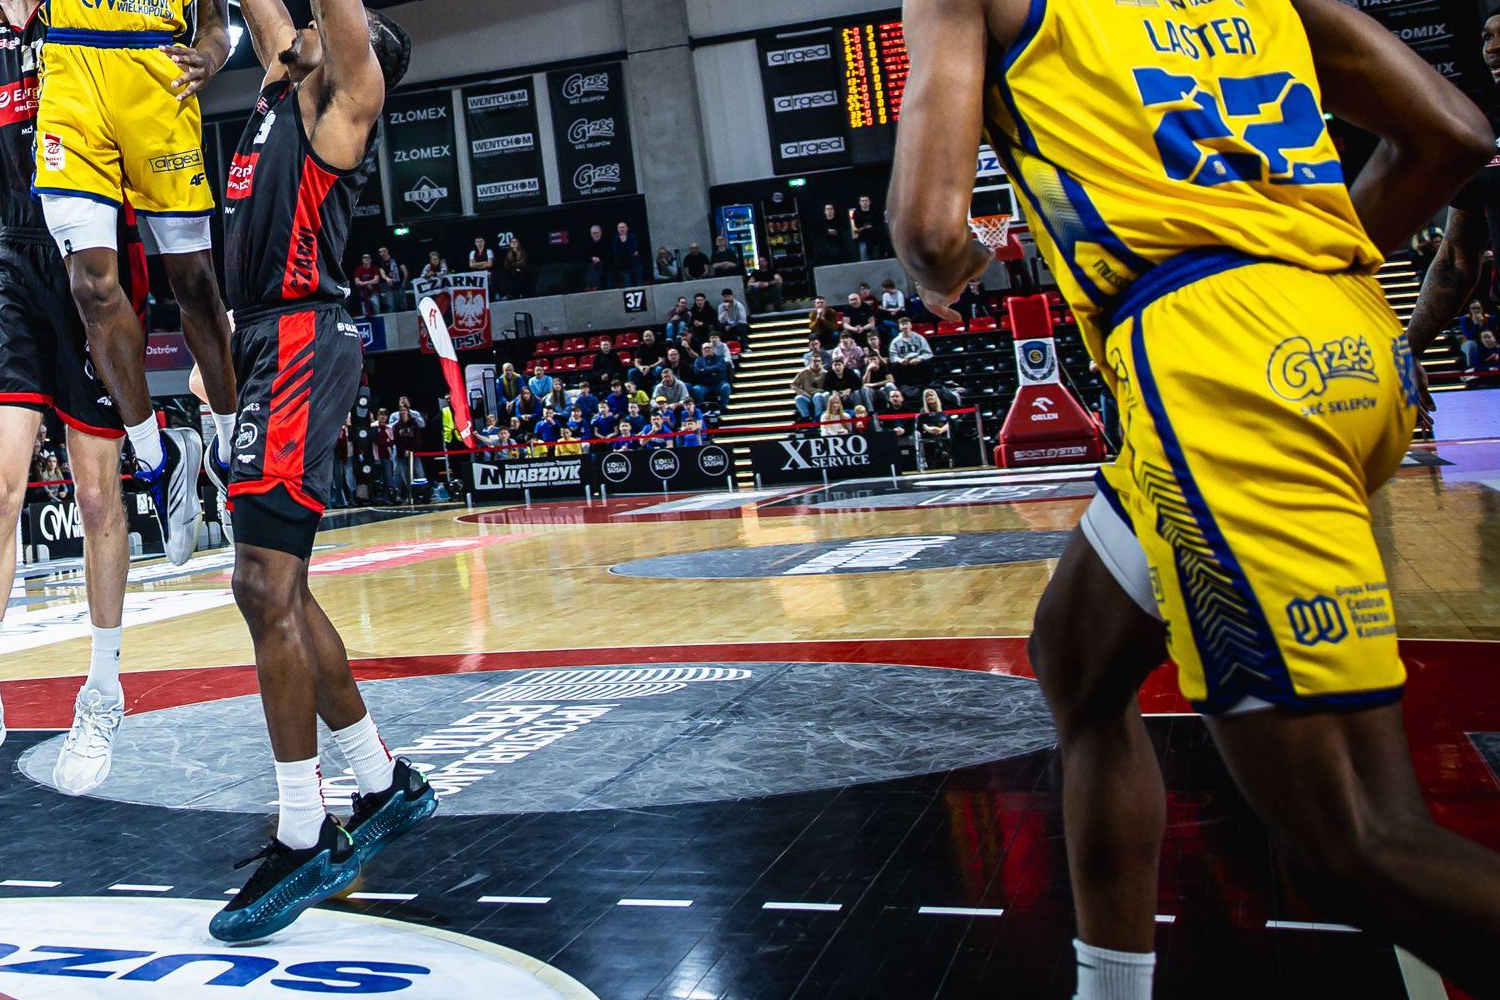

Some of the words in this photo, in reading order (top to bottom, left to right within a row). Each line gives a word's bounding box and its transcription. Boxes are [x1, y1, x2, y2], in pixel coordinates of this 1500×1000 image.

[1143, 16, 1257, 61] LASTER
[1391, 23, 1447, 41] SOMIX
[562, 72, 610, 100] Grześ
[389, 106, 448, 125] ZŁOMEX
[567, 117, 616, 145] Grześ
[393, 144, 451, 164] ZŁOMEX
[572, 162, 621, 190] Grześ
[624, 291, 644, 308] 37
[1266, 333, 1380, 402] Grześ
[778, 434, 868, 471] XERO
[812, 453, 871, 469] SERVICE
[504, 464, 581, 484] NABZDYK
